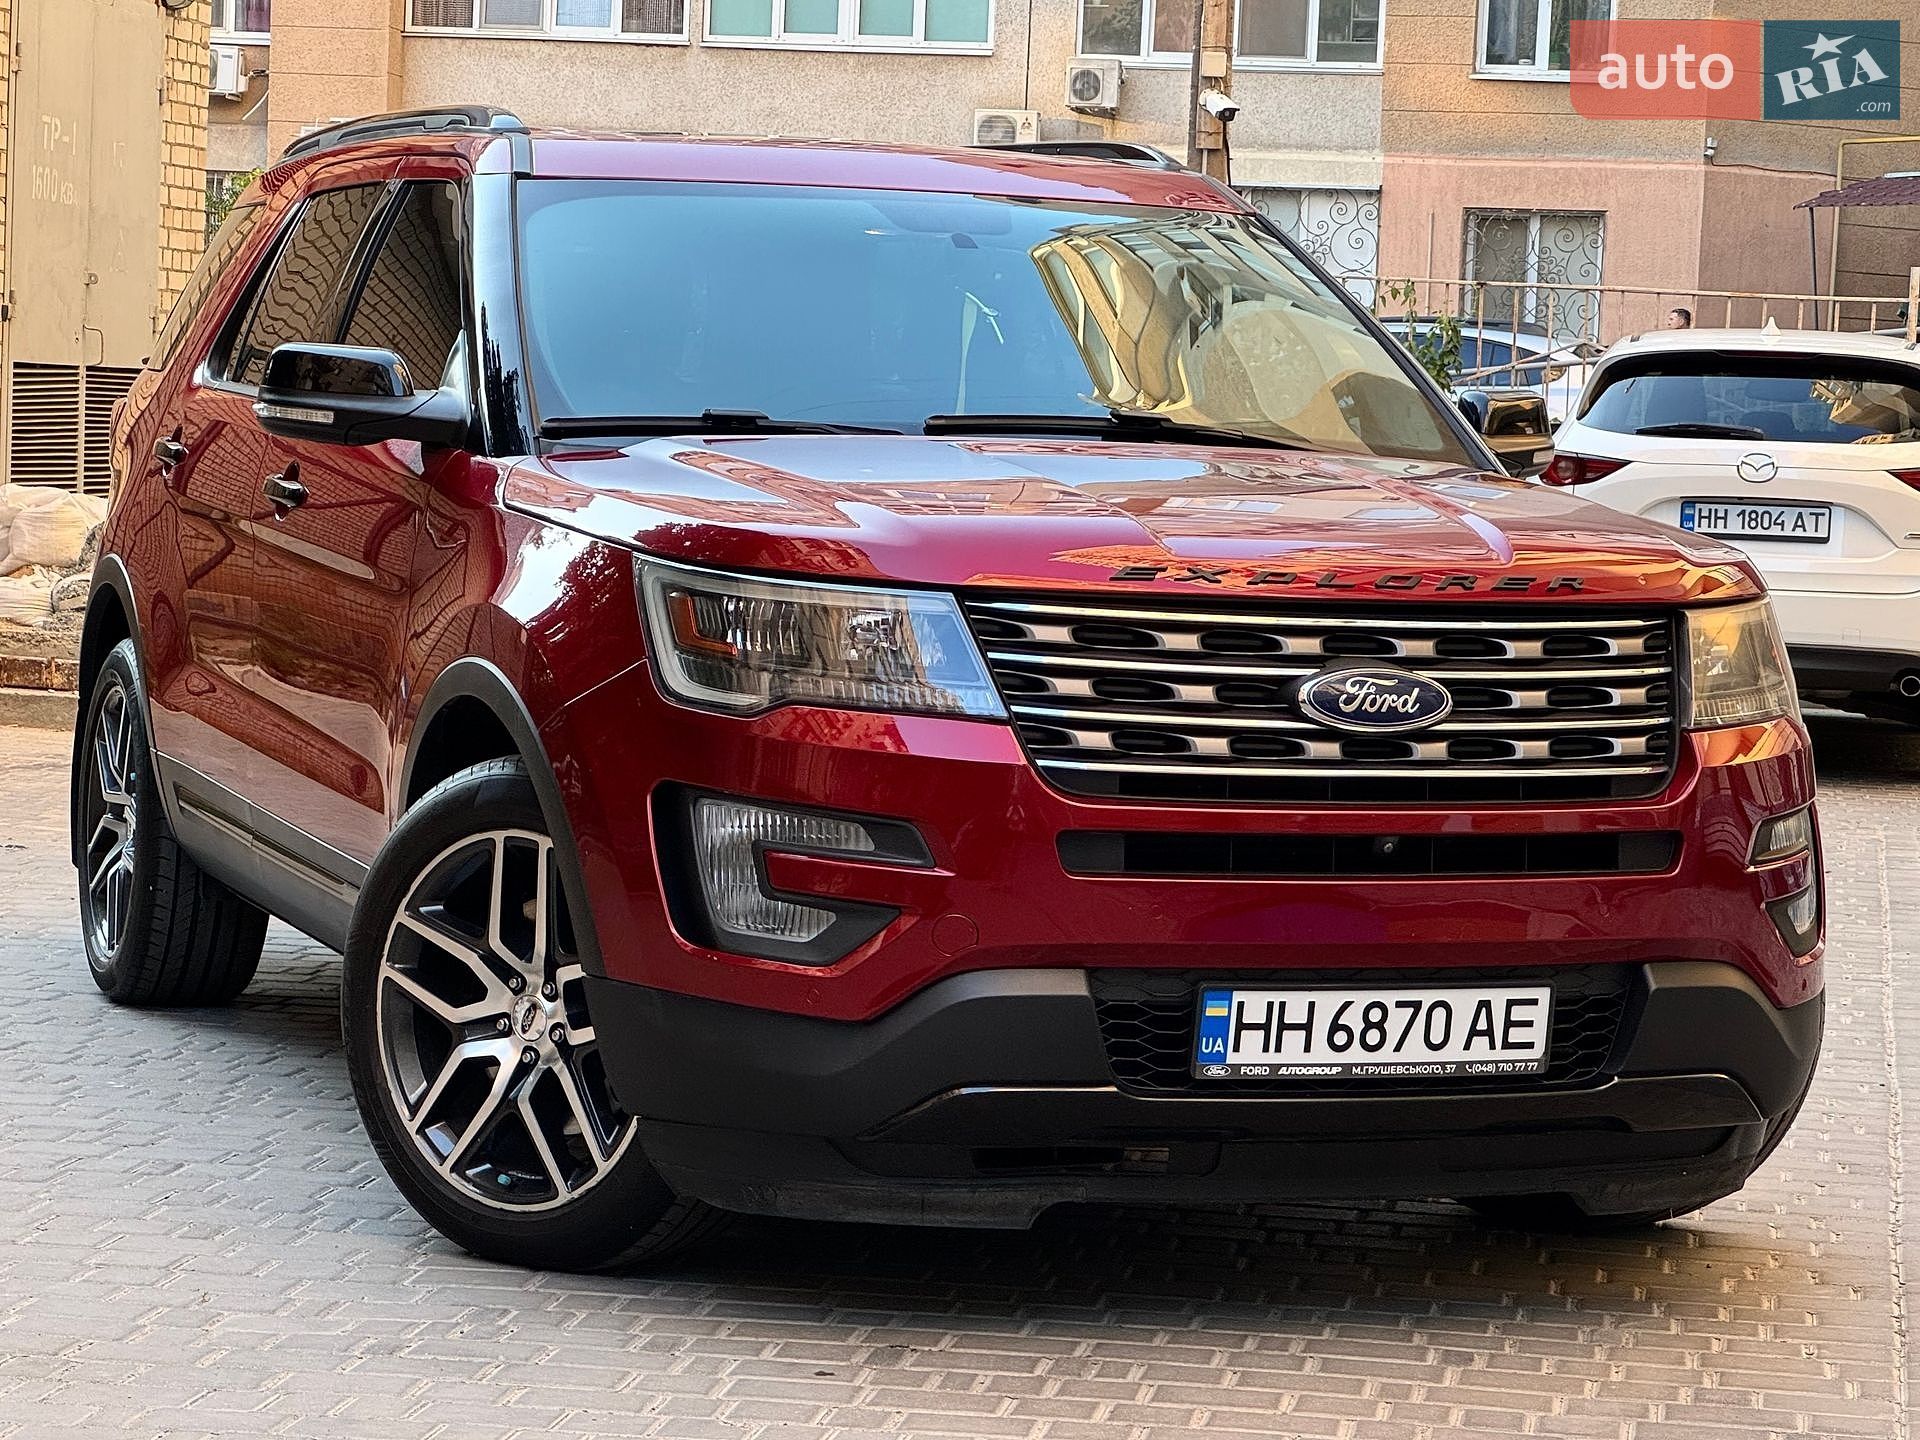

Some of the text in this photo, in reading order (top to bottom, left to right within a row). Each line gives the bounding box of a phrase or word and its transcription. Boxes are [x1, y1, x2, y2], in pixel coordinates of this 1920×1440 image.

[32, 164, 58, 202] 1600
[1697, 507, 1827, 533] HH 1804 AT
[1109, 565, 1584, 592] EXPLORER
[1338, 677, 1421, 714] Ford
[1232, 997, 1540, 1054] HH 6870 AE
[1201, 1037, 1224, 1054] UA
[1240, 1066, 1270, 1076] FORD
[1277, 1066, 1343, 1075] AUTOGROUP
[1445, 1064, 1457, 1074] 37
[1472, 1062, 1538, 1074] (048) 710 77 77
